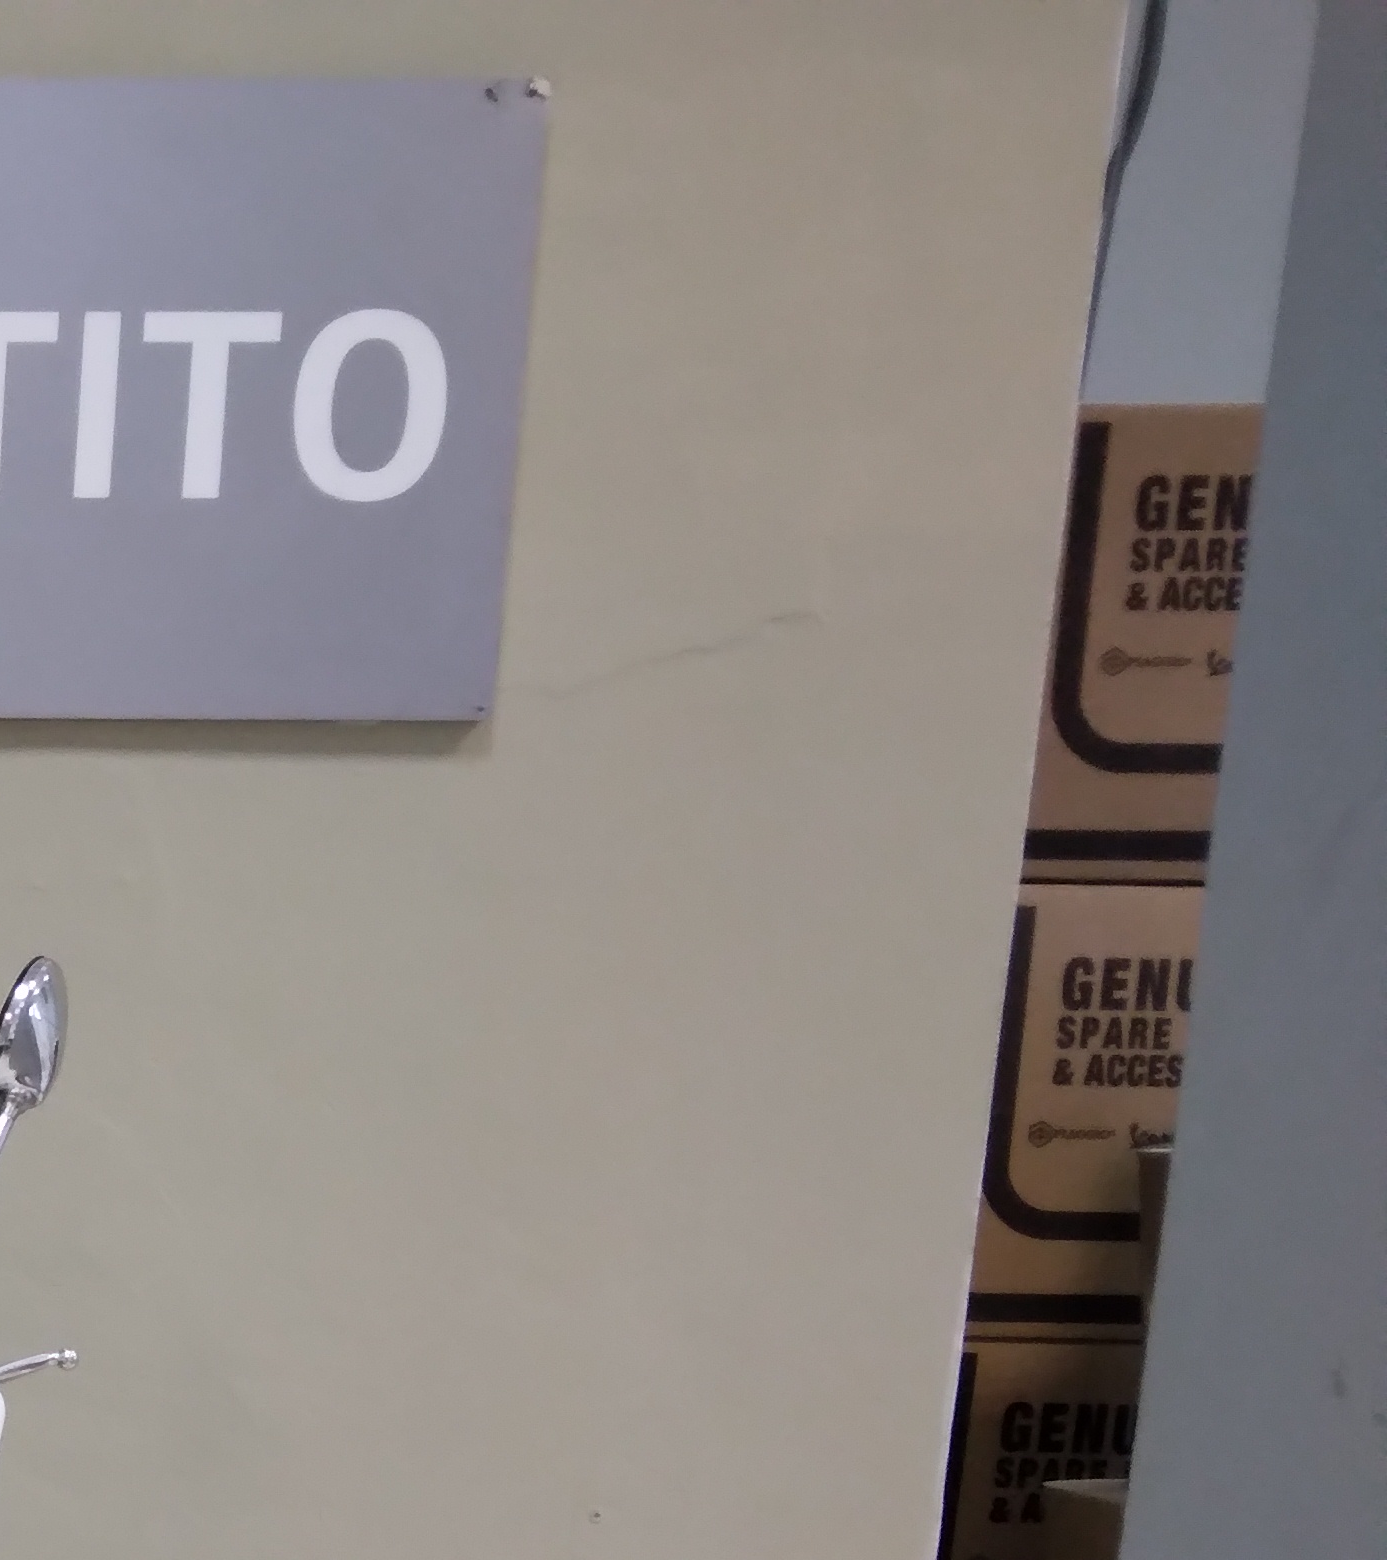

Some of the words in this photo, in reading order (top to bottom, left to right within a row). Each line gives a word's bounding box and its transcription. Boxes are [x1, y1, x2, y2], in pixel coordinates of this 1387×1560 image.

[1130, 538, 1247, 571] SPARE
[1126, 582, 1147, 611] &
[1056, 1017, 1172, 1049] SPARE
[1052, 1059, 1073, 1086] &
[1084, 1054, 1184, 1087] ACCES
